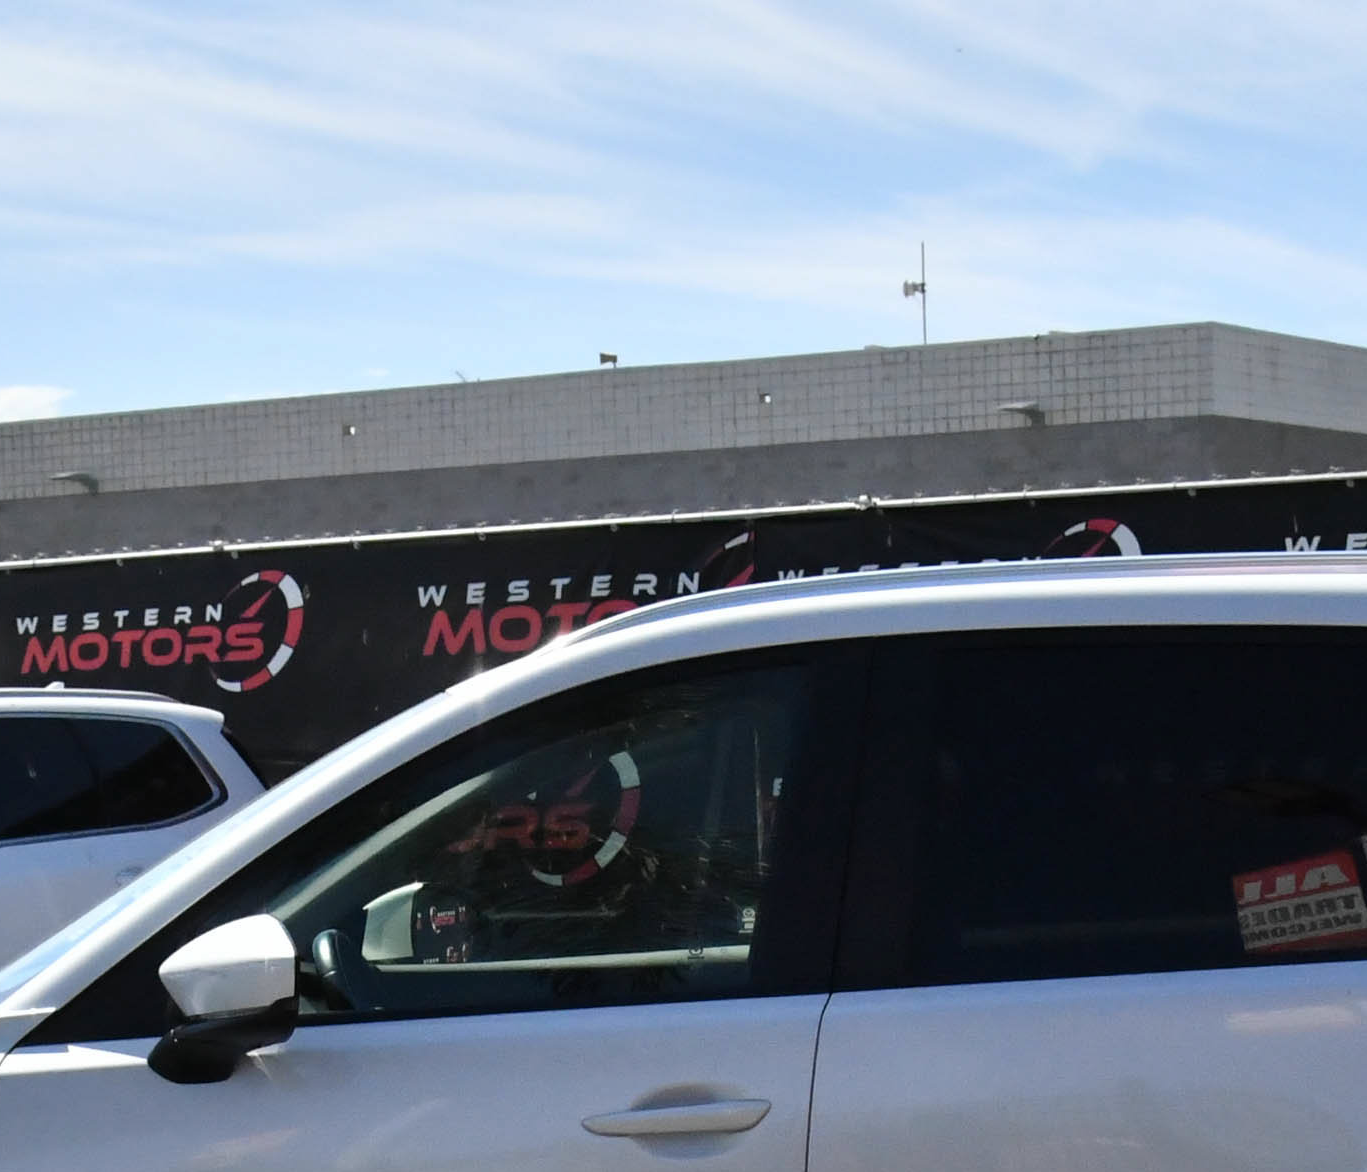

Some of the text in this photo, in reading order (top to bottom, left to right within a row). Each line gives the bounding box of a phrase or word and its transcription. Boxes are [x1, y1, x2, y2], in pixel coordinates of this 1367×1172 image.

[418, 571, 701, 608] WESTERN
[16, 603, 223, 634] WESTERN
[20, 621, 265, 675] MOTORS
